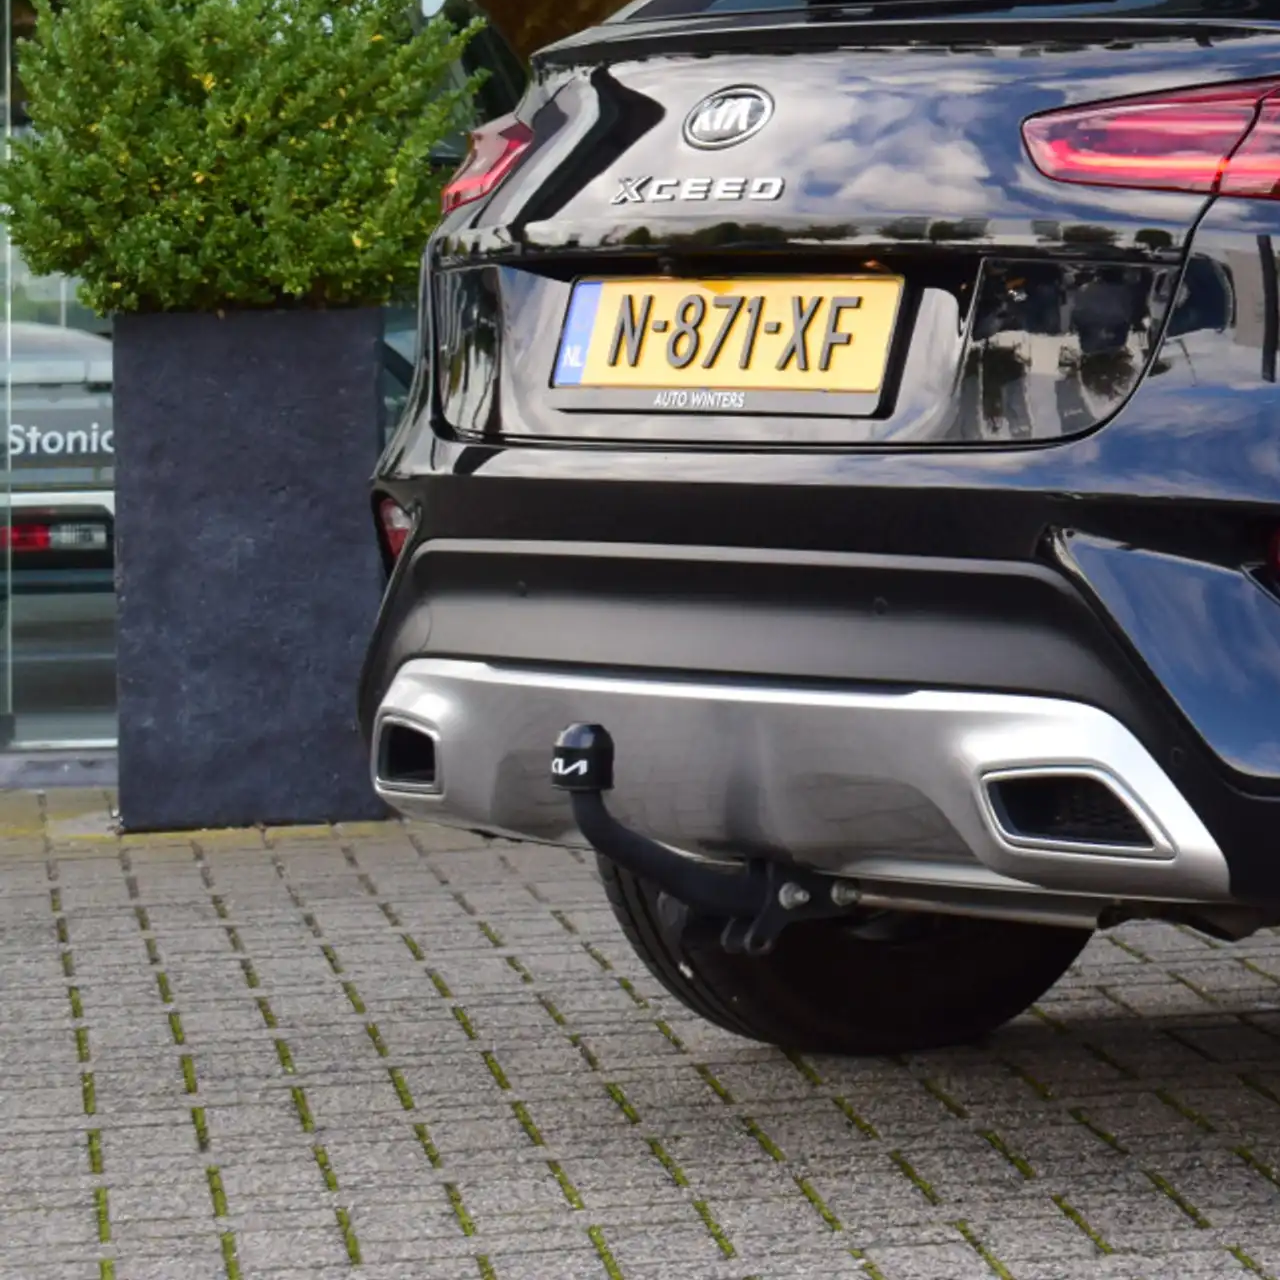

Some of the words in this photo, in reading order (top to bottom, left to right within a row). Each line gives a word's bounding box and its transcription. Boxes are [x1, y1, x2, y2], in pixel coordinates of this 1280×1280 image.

[610, 175, 785, 205] XCEED
[607, 293, 863, 372] N-871-XF
[562, 345, 584, 368] NL
[653, 391, 688, 408] AUTO
[690, 391, 746, 409] WINTERS
[8, 422, 115, 456] Stonic
